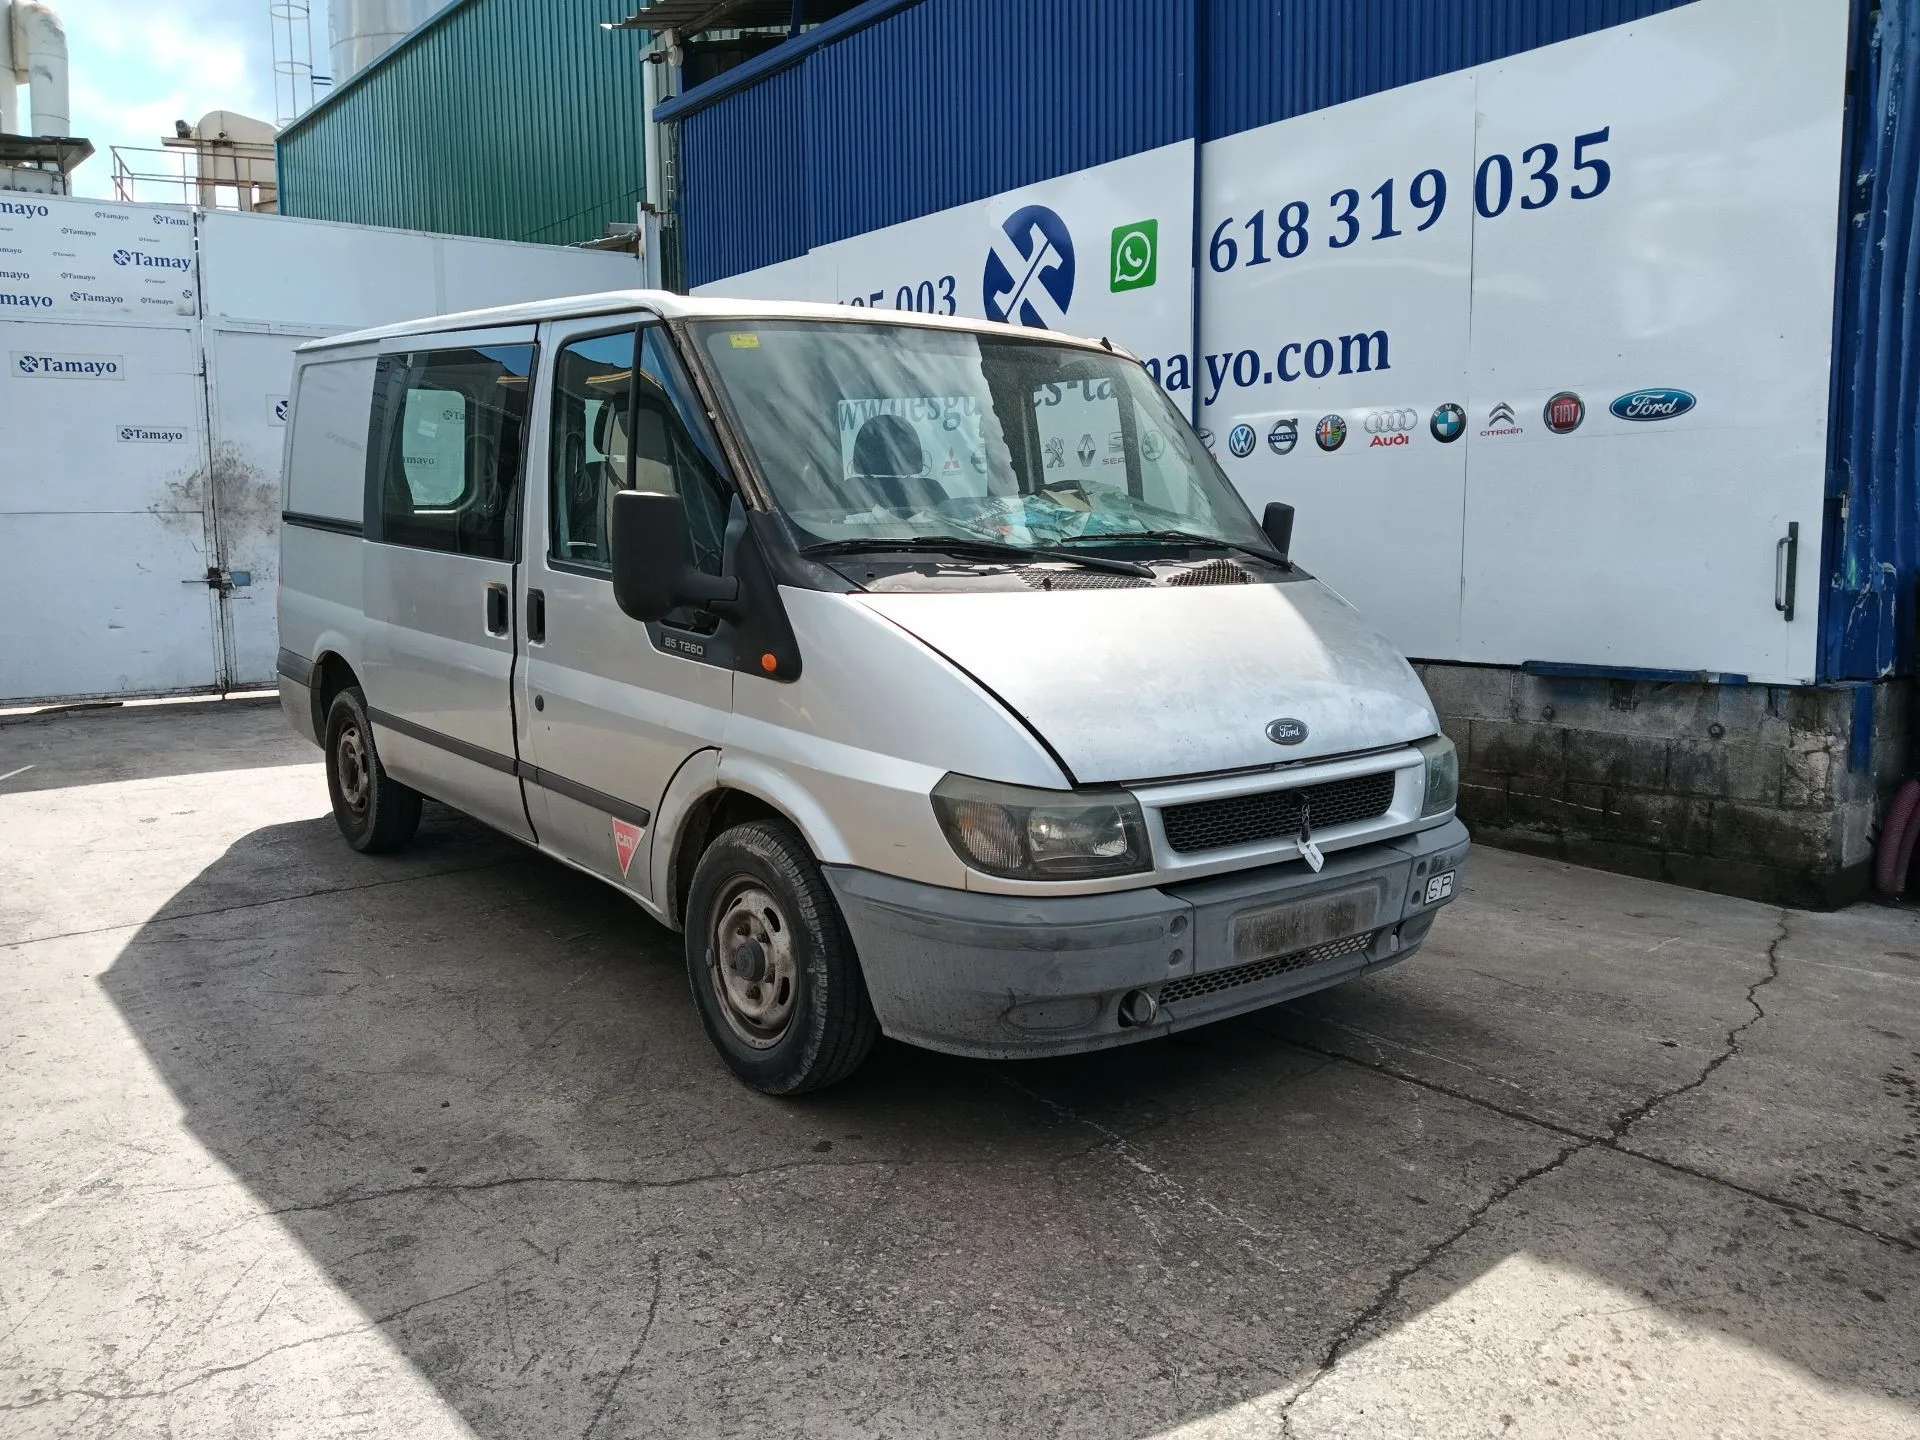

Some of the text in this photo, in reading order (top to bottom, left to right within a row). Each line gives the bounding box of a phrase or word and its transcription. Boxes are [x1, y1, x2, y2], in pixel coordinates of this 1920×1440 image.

[1208, 126, 1612, 274] 618 319 035
[69, 228, 97, 237] Tamayo
[131, 251, 192, 273] Tamay
[68, 272, 96, 281] Tamayo
[81, 292, 124, 305] Tamayo
[148, 297, 174, 306] Tamayo
[40, 357, 117, 377] Tamayo
[1626, 394, 1679, 416] Ford
[1554, 404, 1576, 424] FIAT
[134, 428, 183, 442] Tamayo
[1270, 433, 1296, 441] VOLVO
[1370, 433, 1410, 447] Audi
[664, 637, 704, 655] 85 T260
[1279, 724, 1301, 738] Ford
